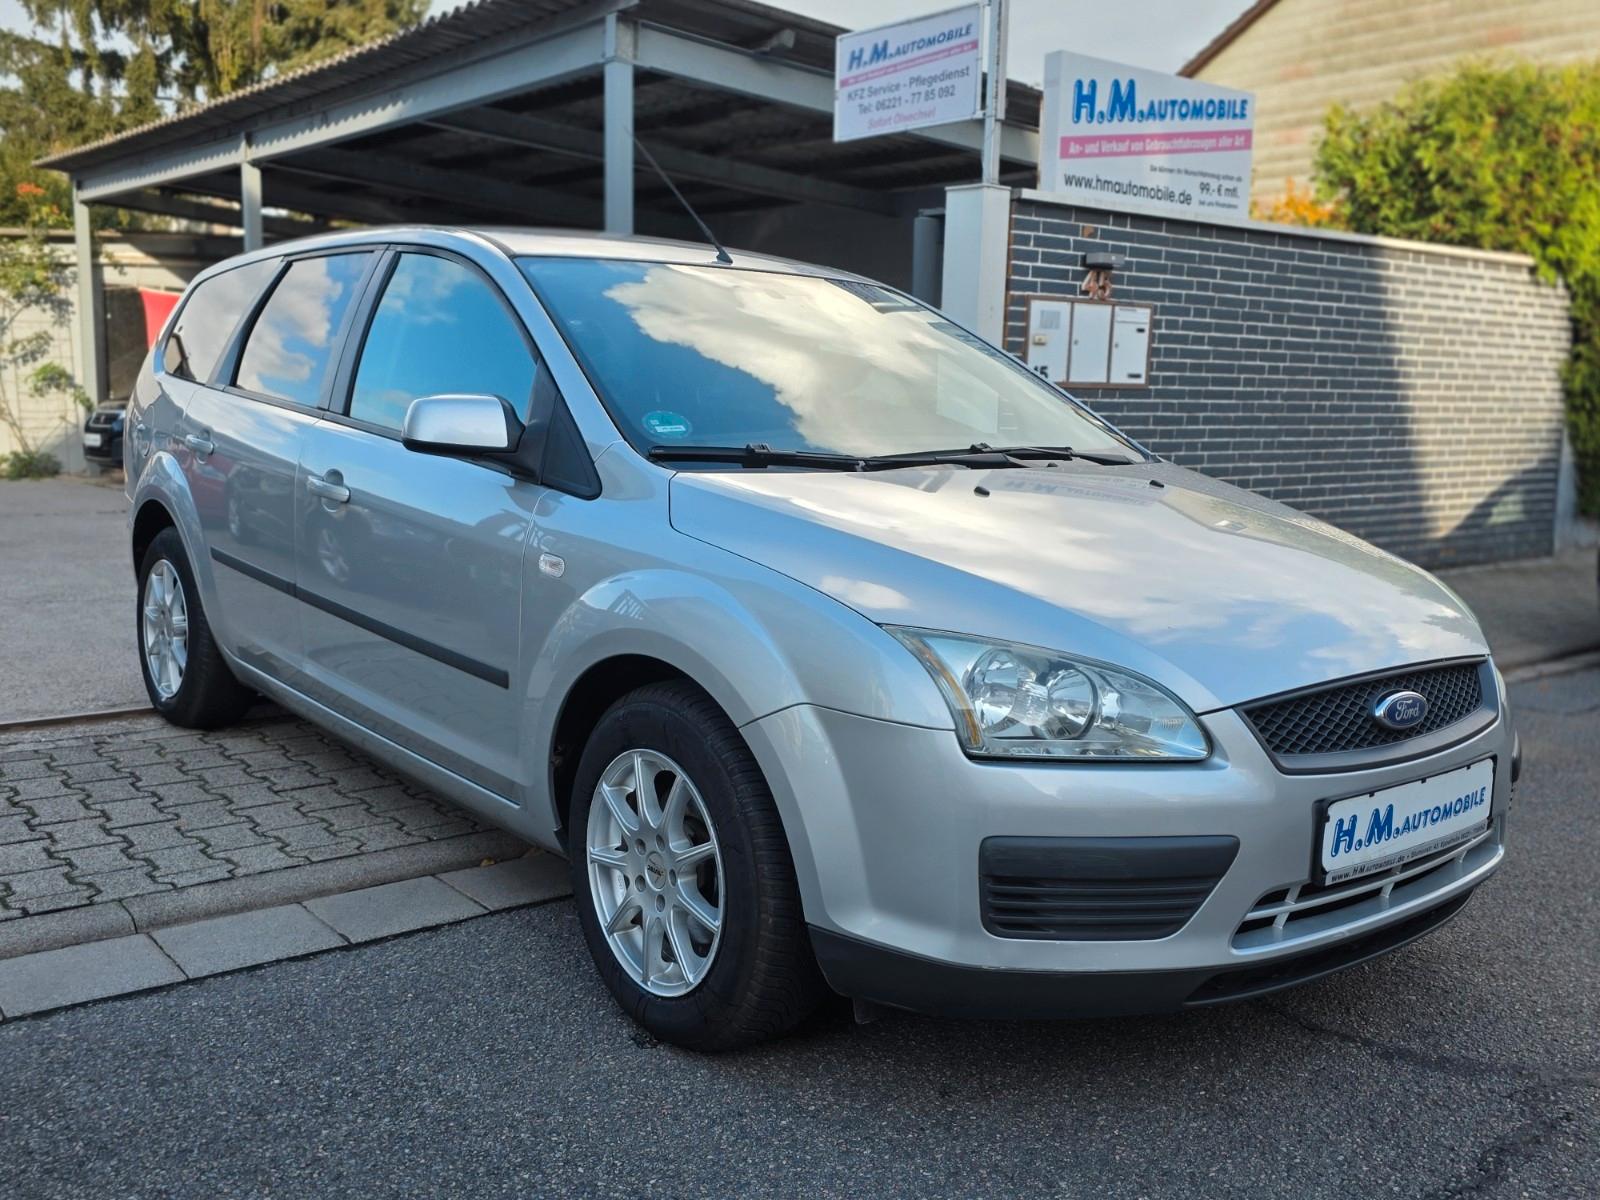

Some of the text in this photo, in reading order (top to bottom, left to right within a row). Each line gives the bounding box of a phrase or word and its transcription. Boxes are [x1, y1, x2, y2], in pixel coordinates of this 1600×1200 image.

[847, 88, 865, 102] KFZ
[867, 82, 900, 97] Service
[909, 65, 970, 88] Pflegedienst
[911, 92, 922, 103] 77
[938, 85, 956, 99] 092
[1064, 173, 1192, 206] www.hmautomobile.de
[1395, 699, 1420, 721] Ford
